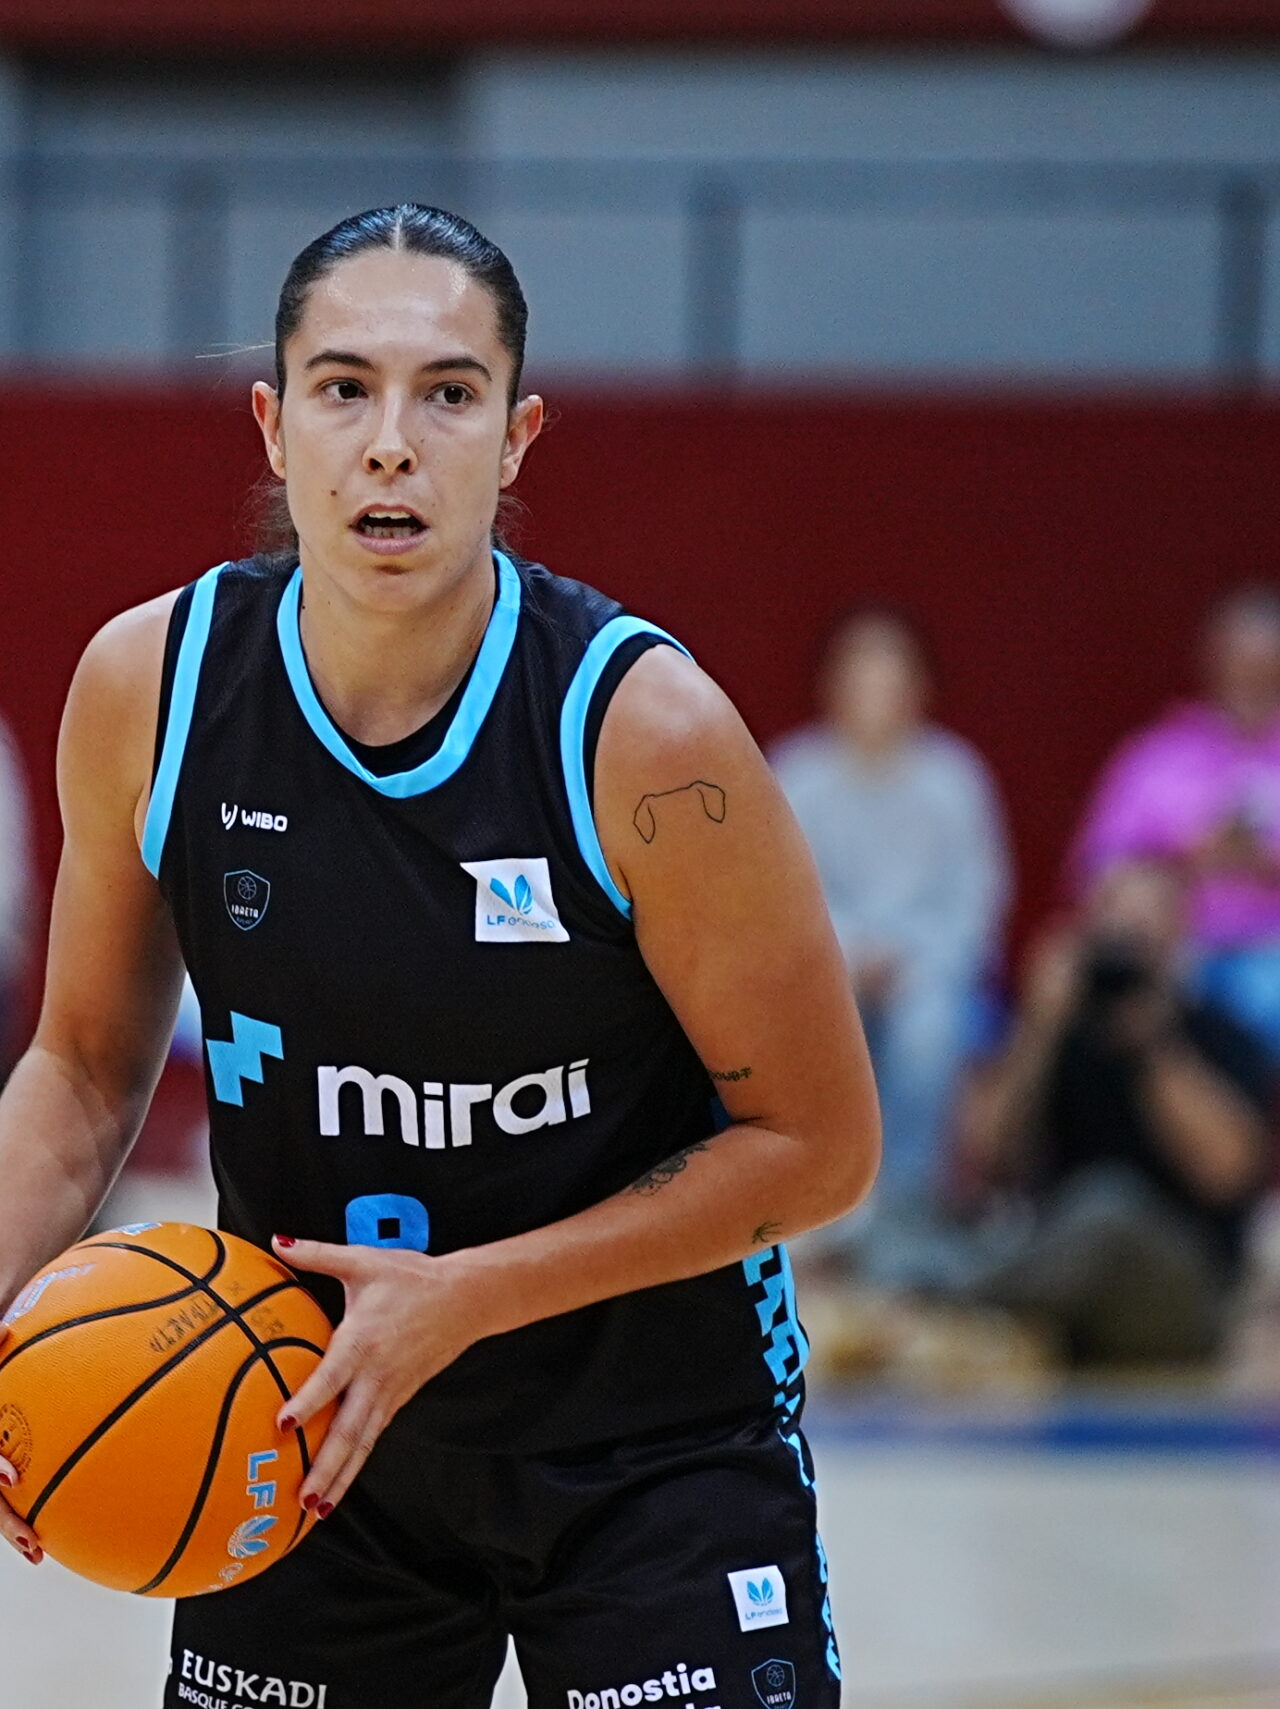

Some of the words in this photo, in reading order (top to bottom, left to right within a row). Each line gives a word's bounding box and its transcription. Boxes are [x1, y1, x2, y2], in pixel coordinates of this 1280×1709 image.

[241, 809, 288, 832] WIBO
[317, 1058, 591, 1149] mirai
[246, 1448, 279, 1509] LF
[181, 1649, 327, 1709] EUSKADI
[567, 1662, 716, 1709] Donostia
